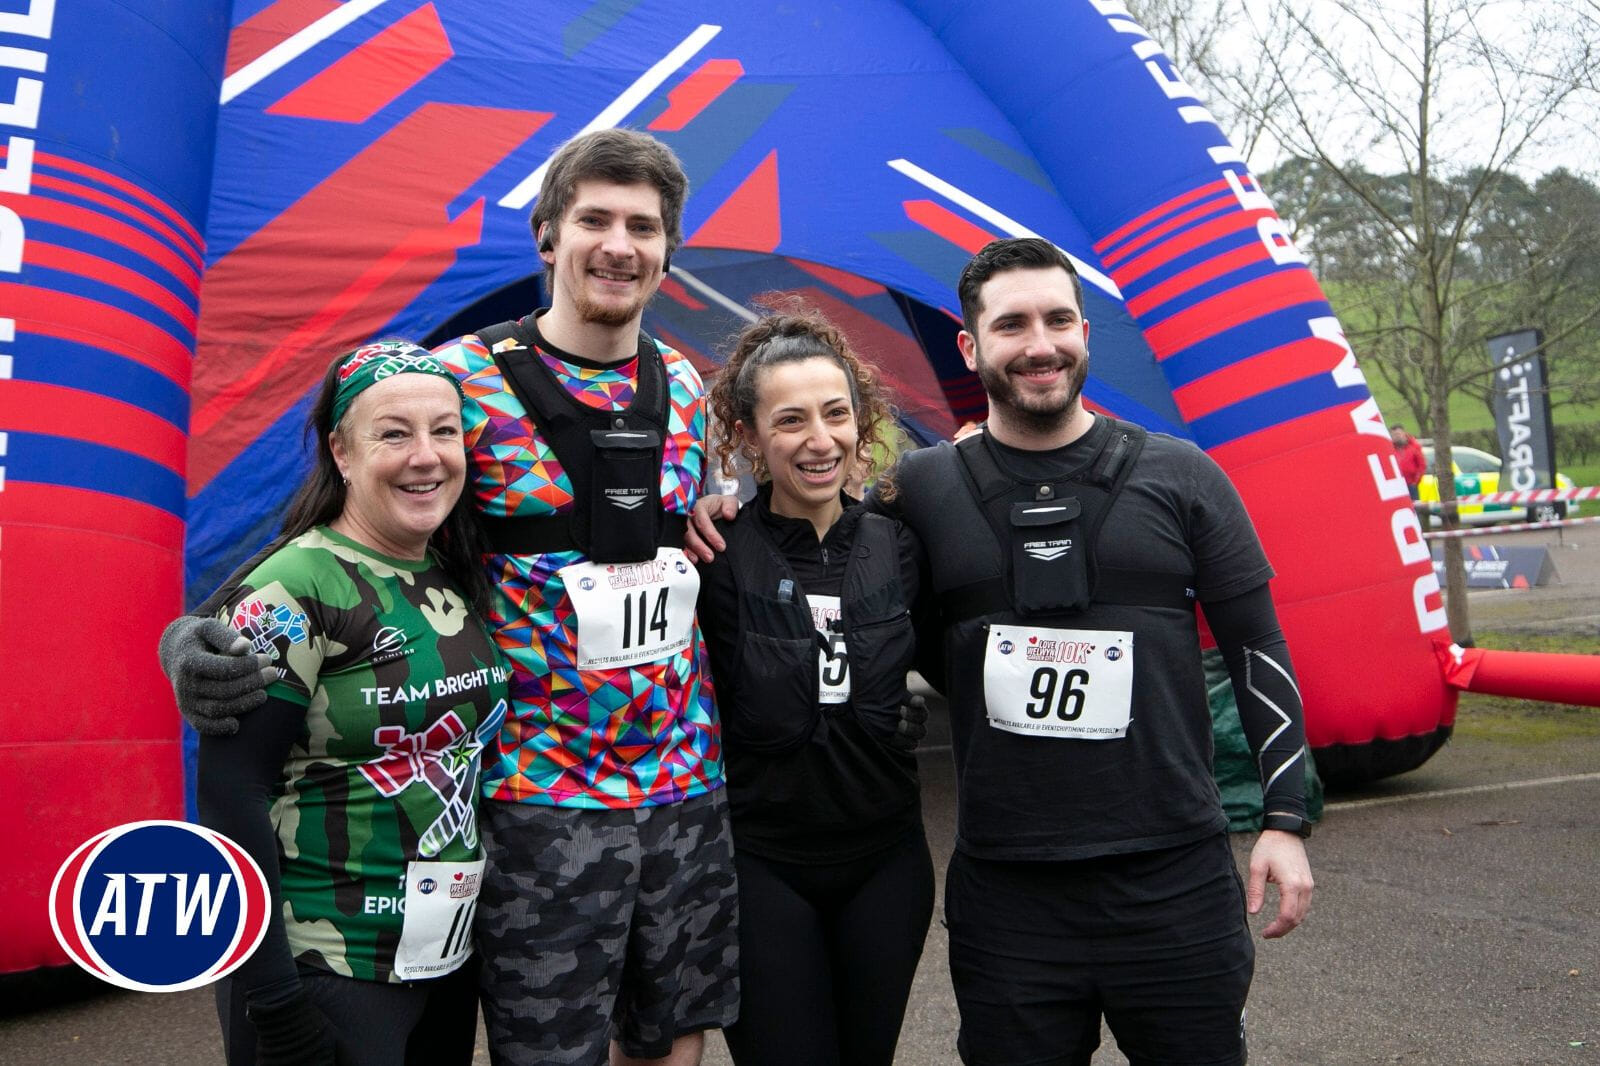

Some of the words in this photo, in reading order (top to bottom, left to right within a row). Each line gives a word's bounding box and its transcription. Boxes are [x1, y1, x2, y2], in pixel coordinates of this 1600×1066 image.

[1023, 541, 1047, 550] FREE
[1047, 538, 1072, 548] TRAIN
[622, 586, 670, 650] 114
[1026, 646, 1056, 657] WELWYN
[1039, 639, 1057, 650] LOVE
[1055, 640, 1090, 664] 10K
[360, 681, 431, 706] TEAM
[434, 667, 489, 697] BRIGHT
[1025, 666, 1090, 721] 96
[1012, 721, 1036, 731] AVAILABLE
[403, 965, 424, 974] RESULTS
